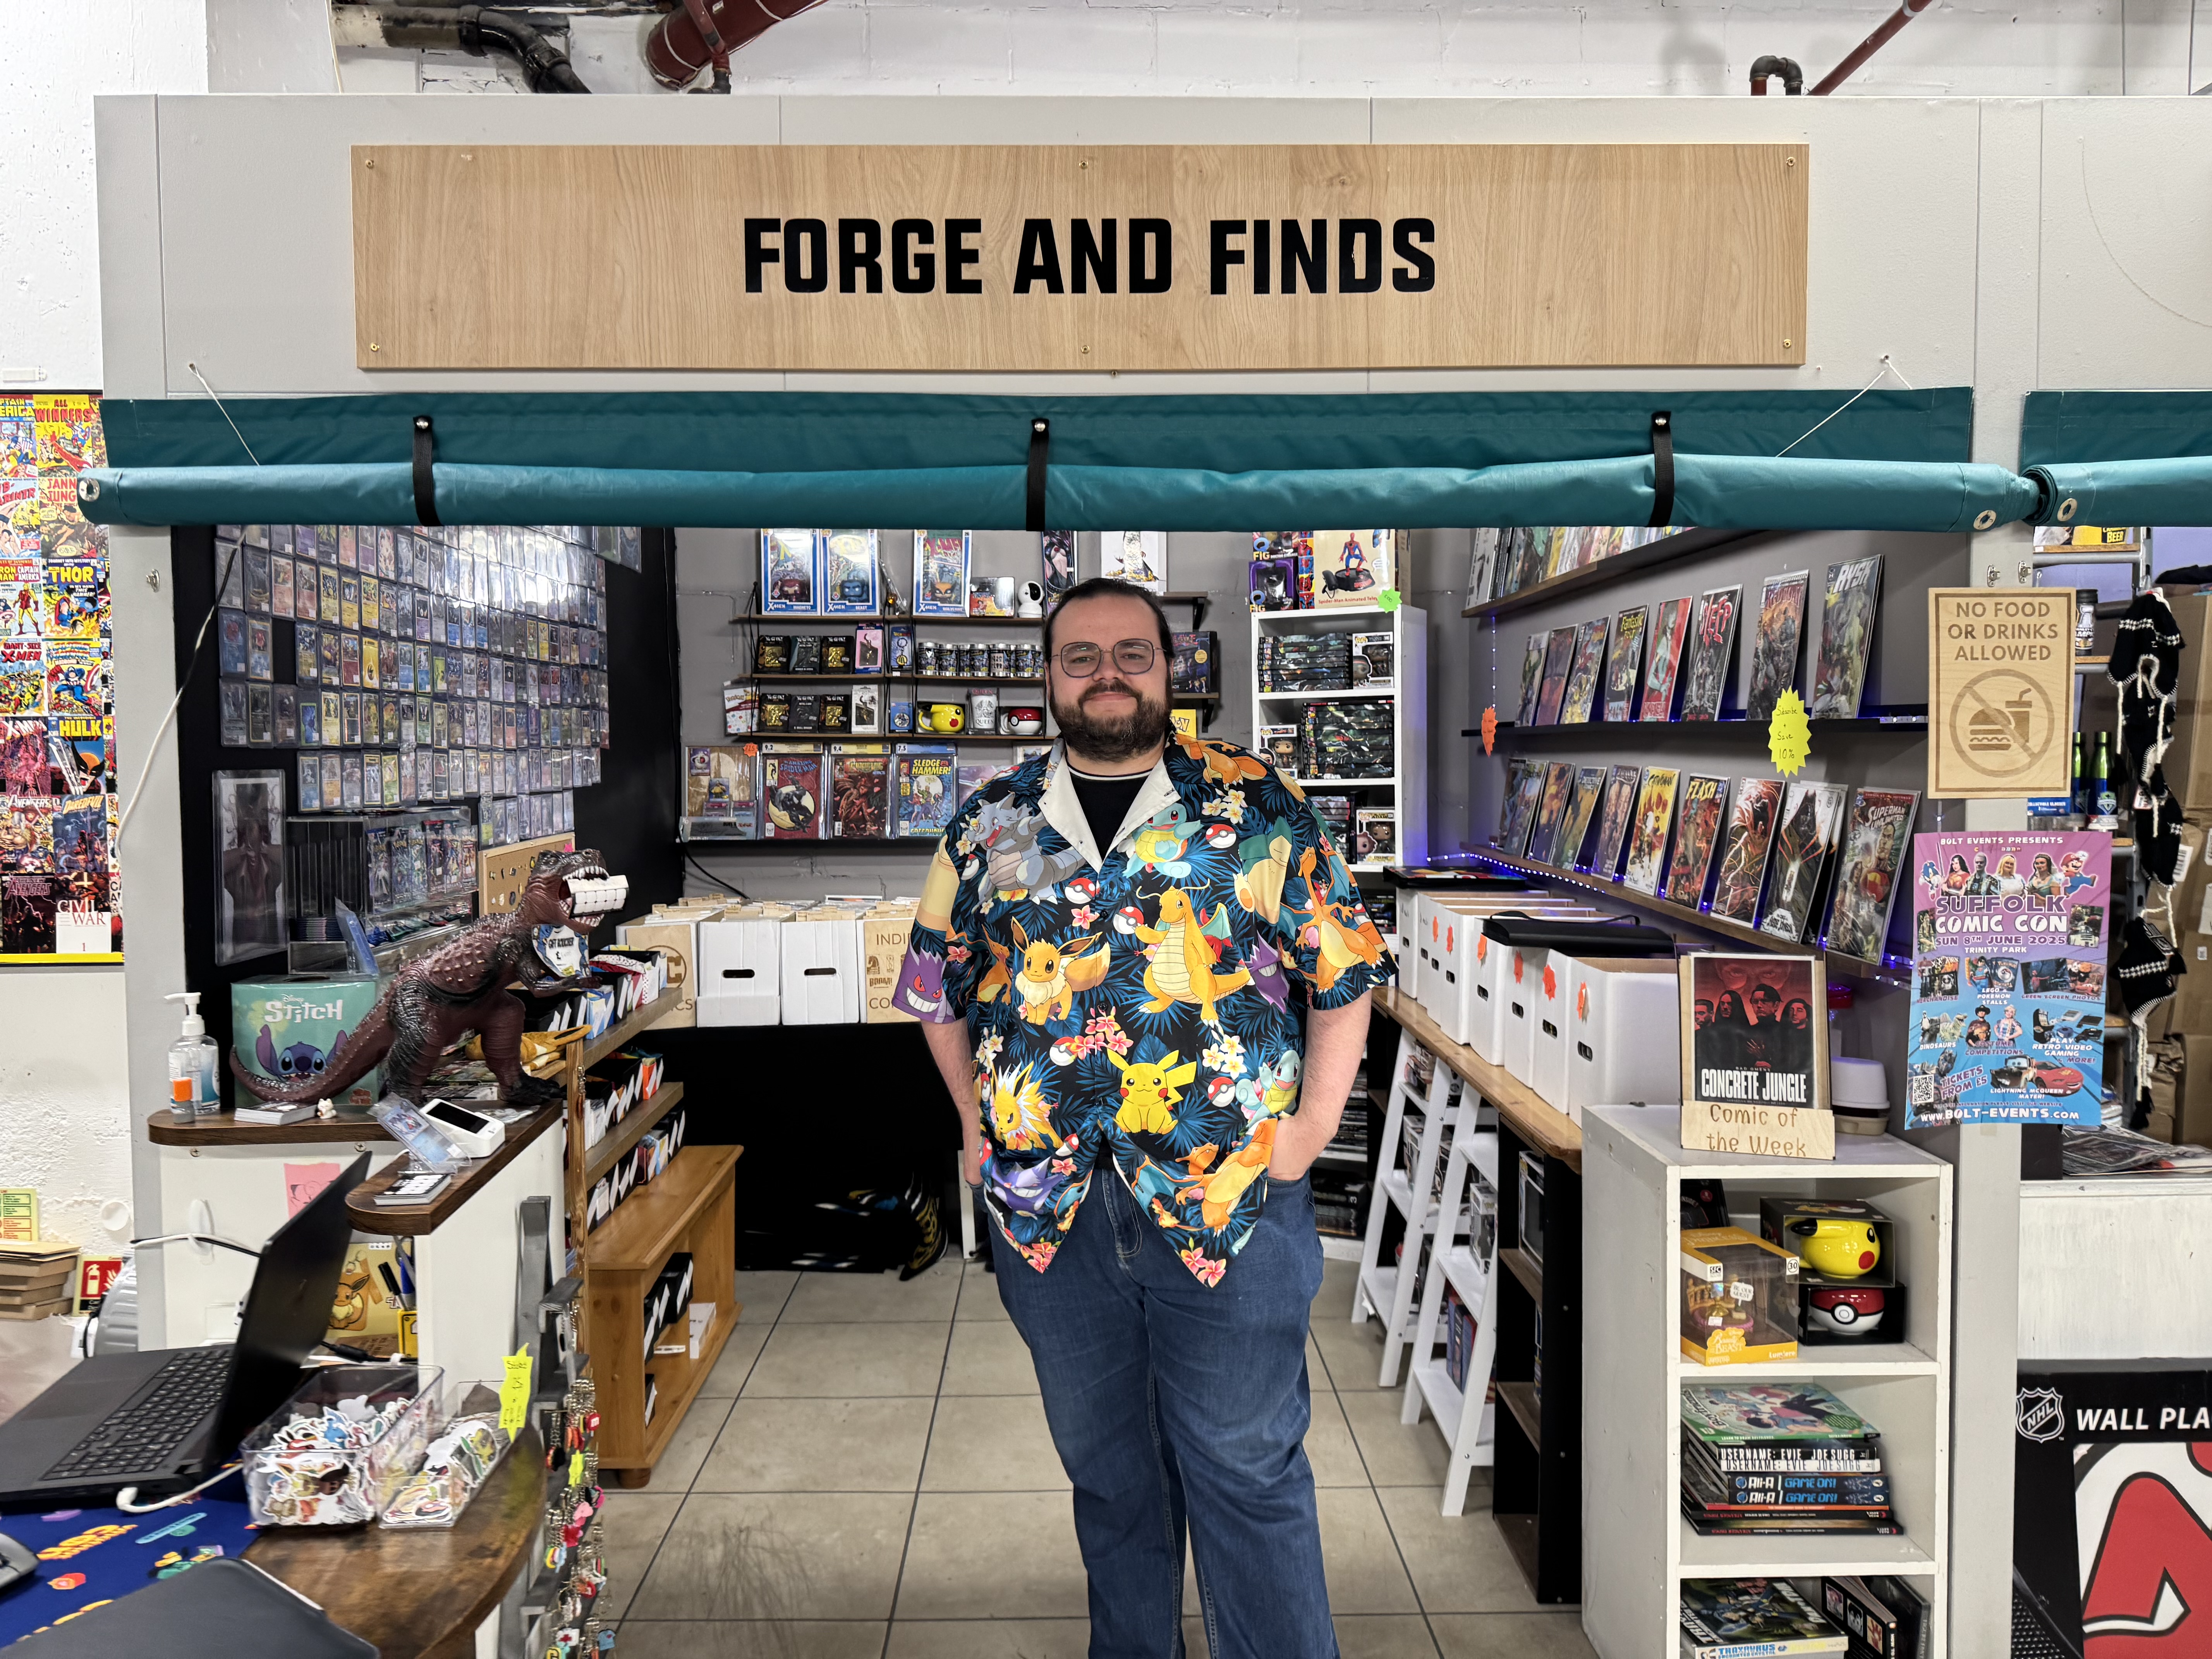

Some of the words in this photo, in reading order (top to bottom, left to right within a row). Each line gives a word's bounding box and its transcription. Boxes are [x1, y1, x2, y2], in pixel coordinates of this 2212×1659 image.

[744, 218, 982, 294] FORGE
[1013, 218, 1172, 294] AND
[1211, 218, 1435, 294] FINDS
[0, 406, 35, 417] ERICA
[35, 408, 91, 422] WINNERS
[47, 479, 77, 489] JANN
[47, 491, 76, 502] JUNG
[2107, 531, 2124, 543] BEER
[1254, 552, 1270, 561] FIG
[48, 566, 94, 583] THOR
[1956, 602, 1986, 617] NO
[1994, 602, 2050, 618] FOOD
[1948, 623, 1977, 639] OR
[1984, 623, 2058, 639] DRINKS
[1, 651, 42, 663] X-MEN
[1954, 645, 2051, 661] ALLOWED
[59, 720, 103, 737] HULK
[1777, 731, 1793, 740] Save
[1779, 748, 1795, 759] 10%
[912, 766, 951, 775] HAMMER!
[1685, 781, 1717, 799] FLASH
[7, 794, 52, 808] AVENGERS
[62, 795, 105, 814] DAREDEVIL
[1865, 805, 1905, 826] SUPERMAN
[58, 900, 96, 913] CIVIL
[1936, 894, 2067, 914] SUFFOLK
[72, 912, 106, 925] WAR
[1936, 914, 2003, 934] COMIC
[2014, 914, 2068, 933] CON
[876, 933, 911, 945] INDI
[1936, 936, 1958, 946] SUN
[1987, 935, 2023, 945] JUNE
[2028, 935, 2066, 945] 2025
[82, 943, 86, 951] 1
[869, 977, 892, 987] BOOM!
[281, 994, 304, 1004] Disney
[1917, 995, 1958, 1003] MERCHANDISE
[1920, 1042, 1956, 1050] DINOSAURS
[1941, 1065, 1984, 1087] TICKETS
[1701, 1068, 1759, 1100] CONCRETE
[1762, 1071, 1806, 1103] JUNGLE
[1941, 1081, 1972, 1098] FROM
[1976, 1075, 1987, 1087] £5
[1710, 1104, 1769, 1126] Comic
[1778, 1108, 1798, 1127] of
[1920, 1108, 2079, 1122] WWW.BOLT-EVENTS.COM
[1706, 1132, 1739, 1152] the
[1749, 1135, 1806, 1157] Week
[1788, 1262, 1797, 1270] 30
[1733, 1291, 1750, 1299] GUEST
[1741, 1286, 1752, 1294] OUR
[1716, 1342, 1743, 1354] BEAST
[2027, 1401, 2054, 1432] NHL
[2076, 1408, 2149, 1431] WALL
[2159, 1407, 2212, 1429] PLA
[1721, 1448, 1776, 1460] USERNAME:
[1781, 1449, 1802, 1460] EVIE
[1811, 1449, 1828, 1460] JOE
[1831, 1449, 1855, 1460] SUGG
[1727, 1460, 1781, 1471] USERNAME:
[1786, 1460, 1807, 1471] EVIE
[1817, 1460, 1834, 1471] JOE
[1837, 1460, 1861, 1470] SUGG
[1784, 1477, 1814, 1488] GAME
[1817, 1478, 1836, 1488] ON!
[1785, 1493, 1816, 1503] GAME
[1819, 1492, 1838, 1503] ON!
